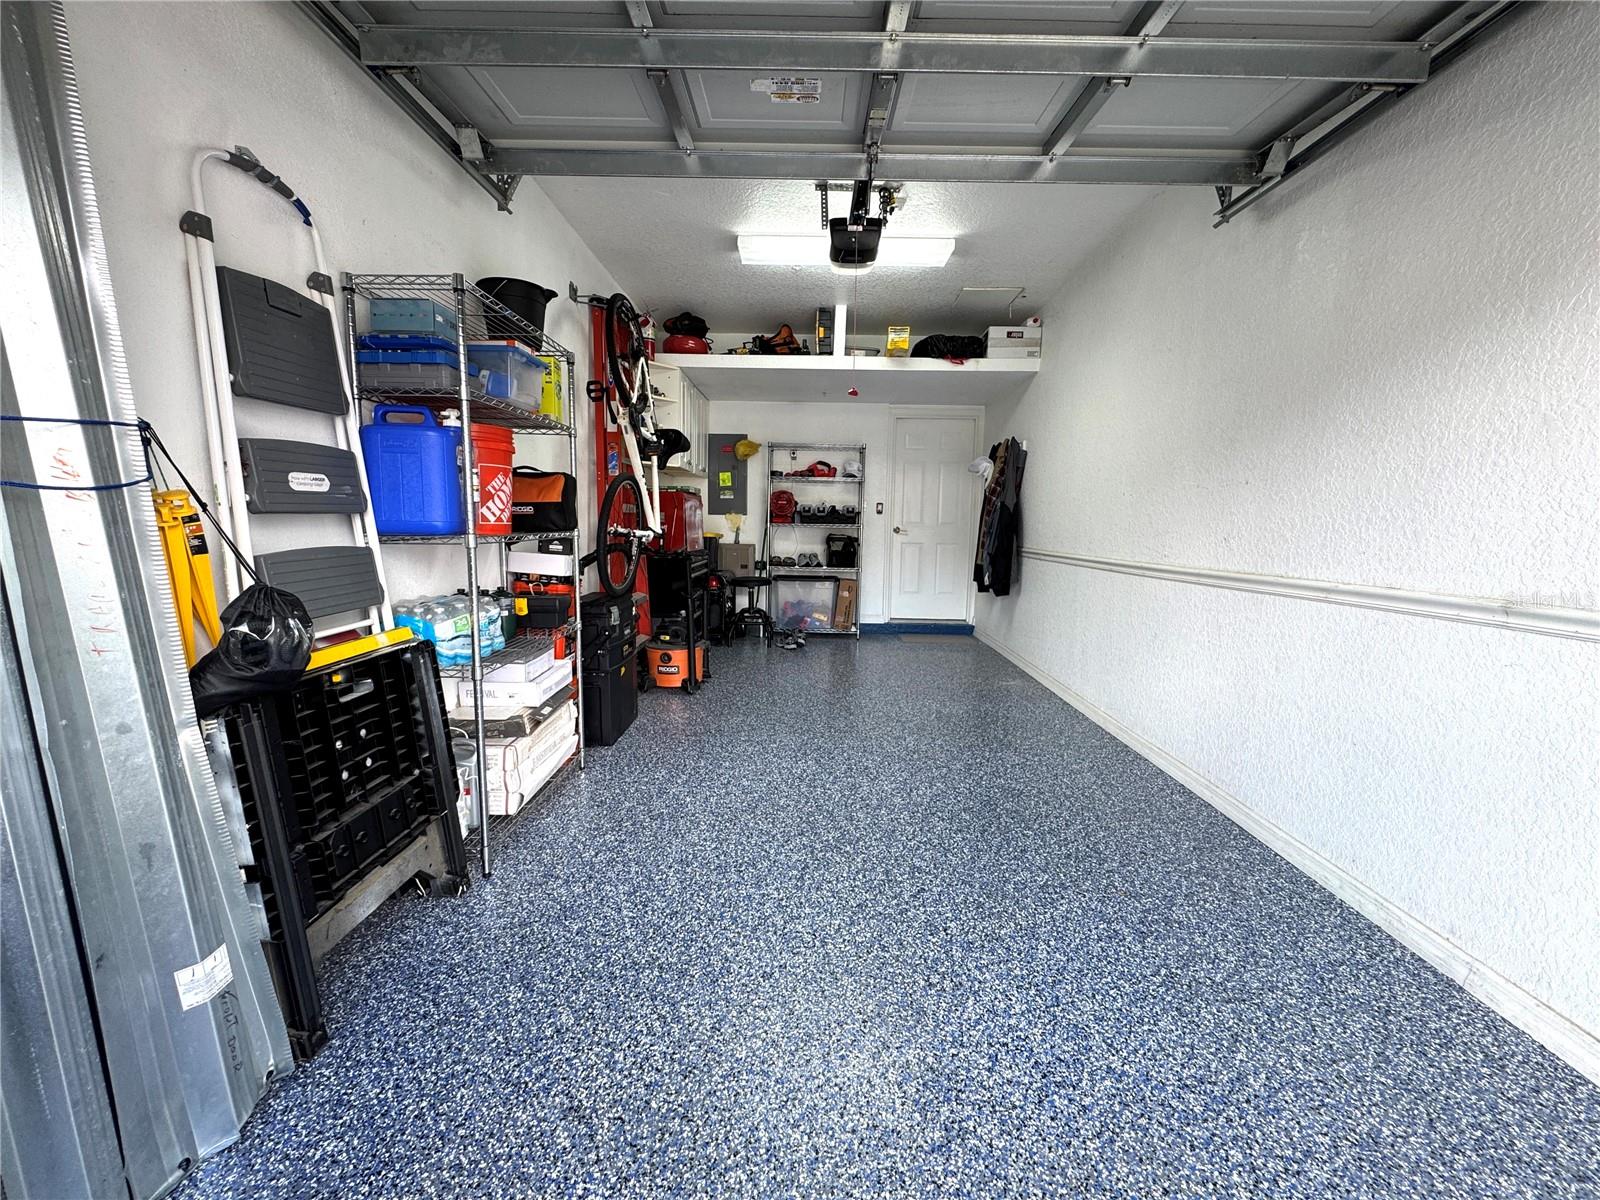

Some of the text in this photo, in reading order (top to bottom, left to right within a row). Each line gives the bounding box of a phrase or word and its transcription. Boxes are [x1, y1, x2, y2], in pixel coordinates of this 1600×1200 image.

[485, 471, 507, 495] THE
[480, 471, 512, 523] HOM
[466, 690, 496, 698] FEVAL
